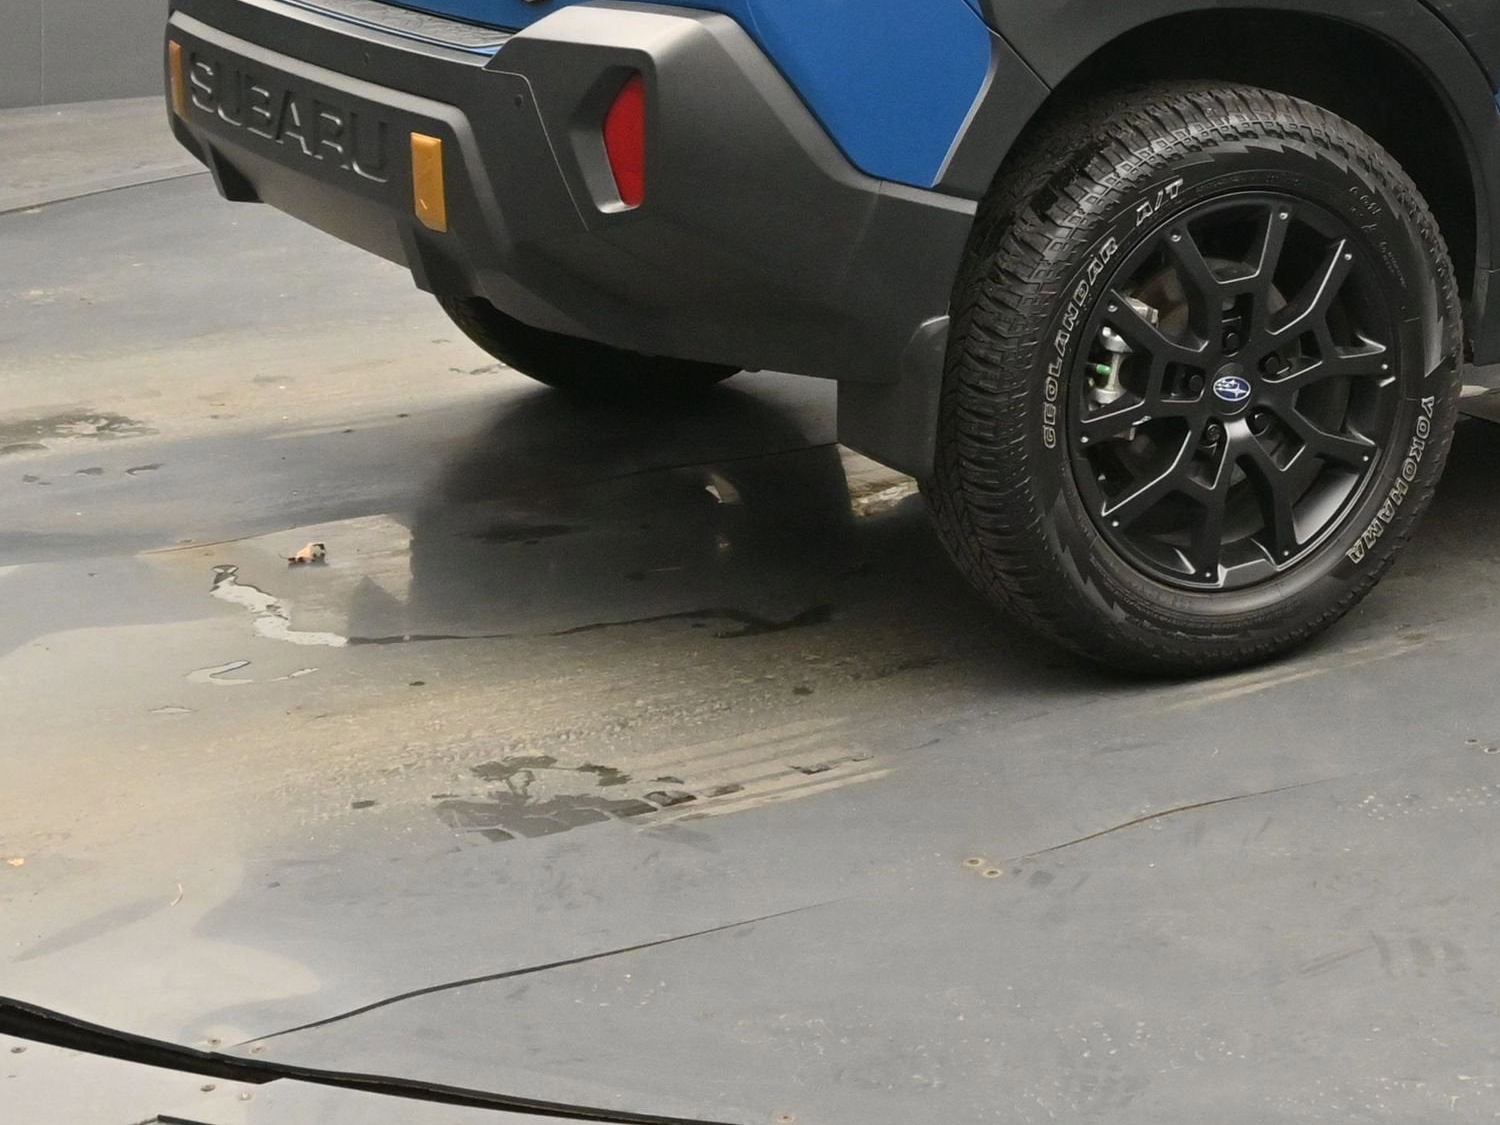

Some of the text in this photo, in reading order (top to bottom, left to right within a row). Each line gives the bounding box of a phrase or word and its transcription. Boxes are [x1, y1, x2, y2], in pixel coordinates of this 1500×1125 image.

[190, 51, 389, 183] SUBARU
[1043, 178, 1184, 449] GEOLANDAR A/T
[1345, 395, 1435, 564] YOKOHAMA
